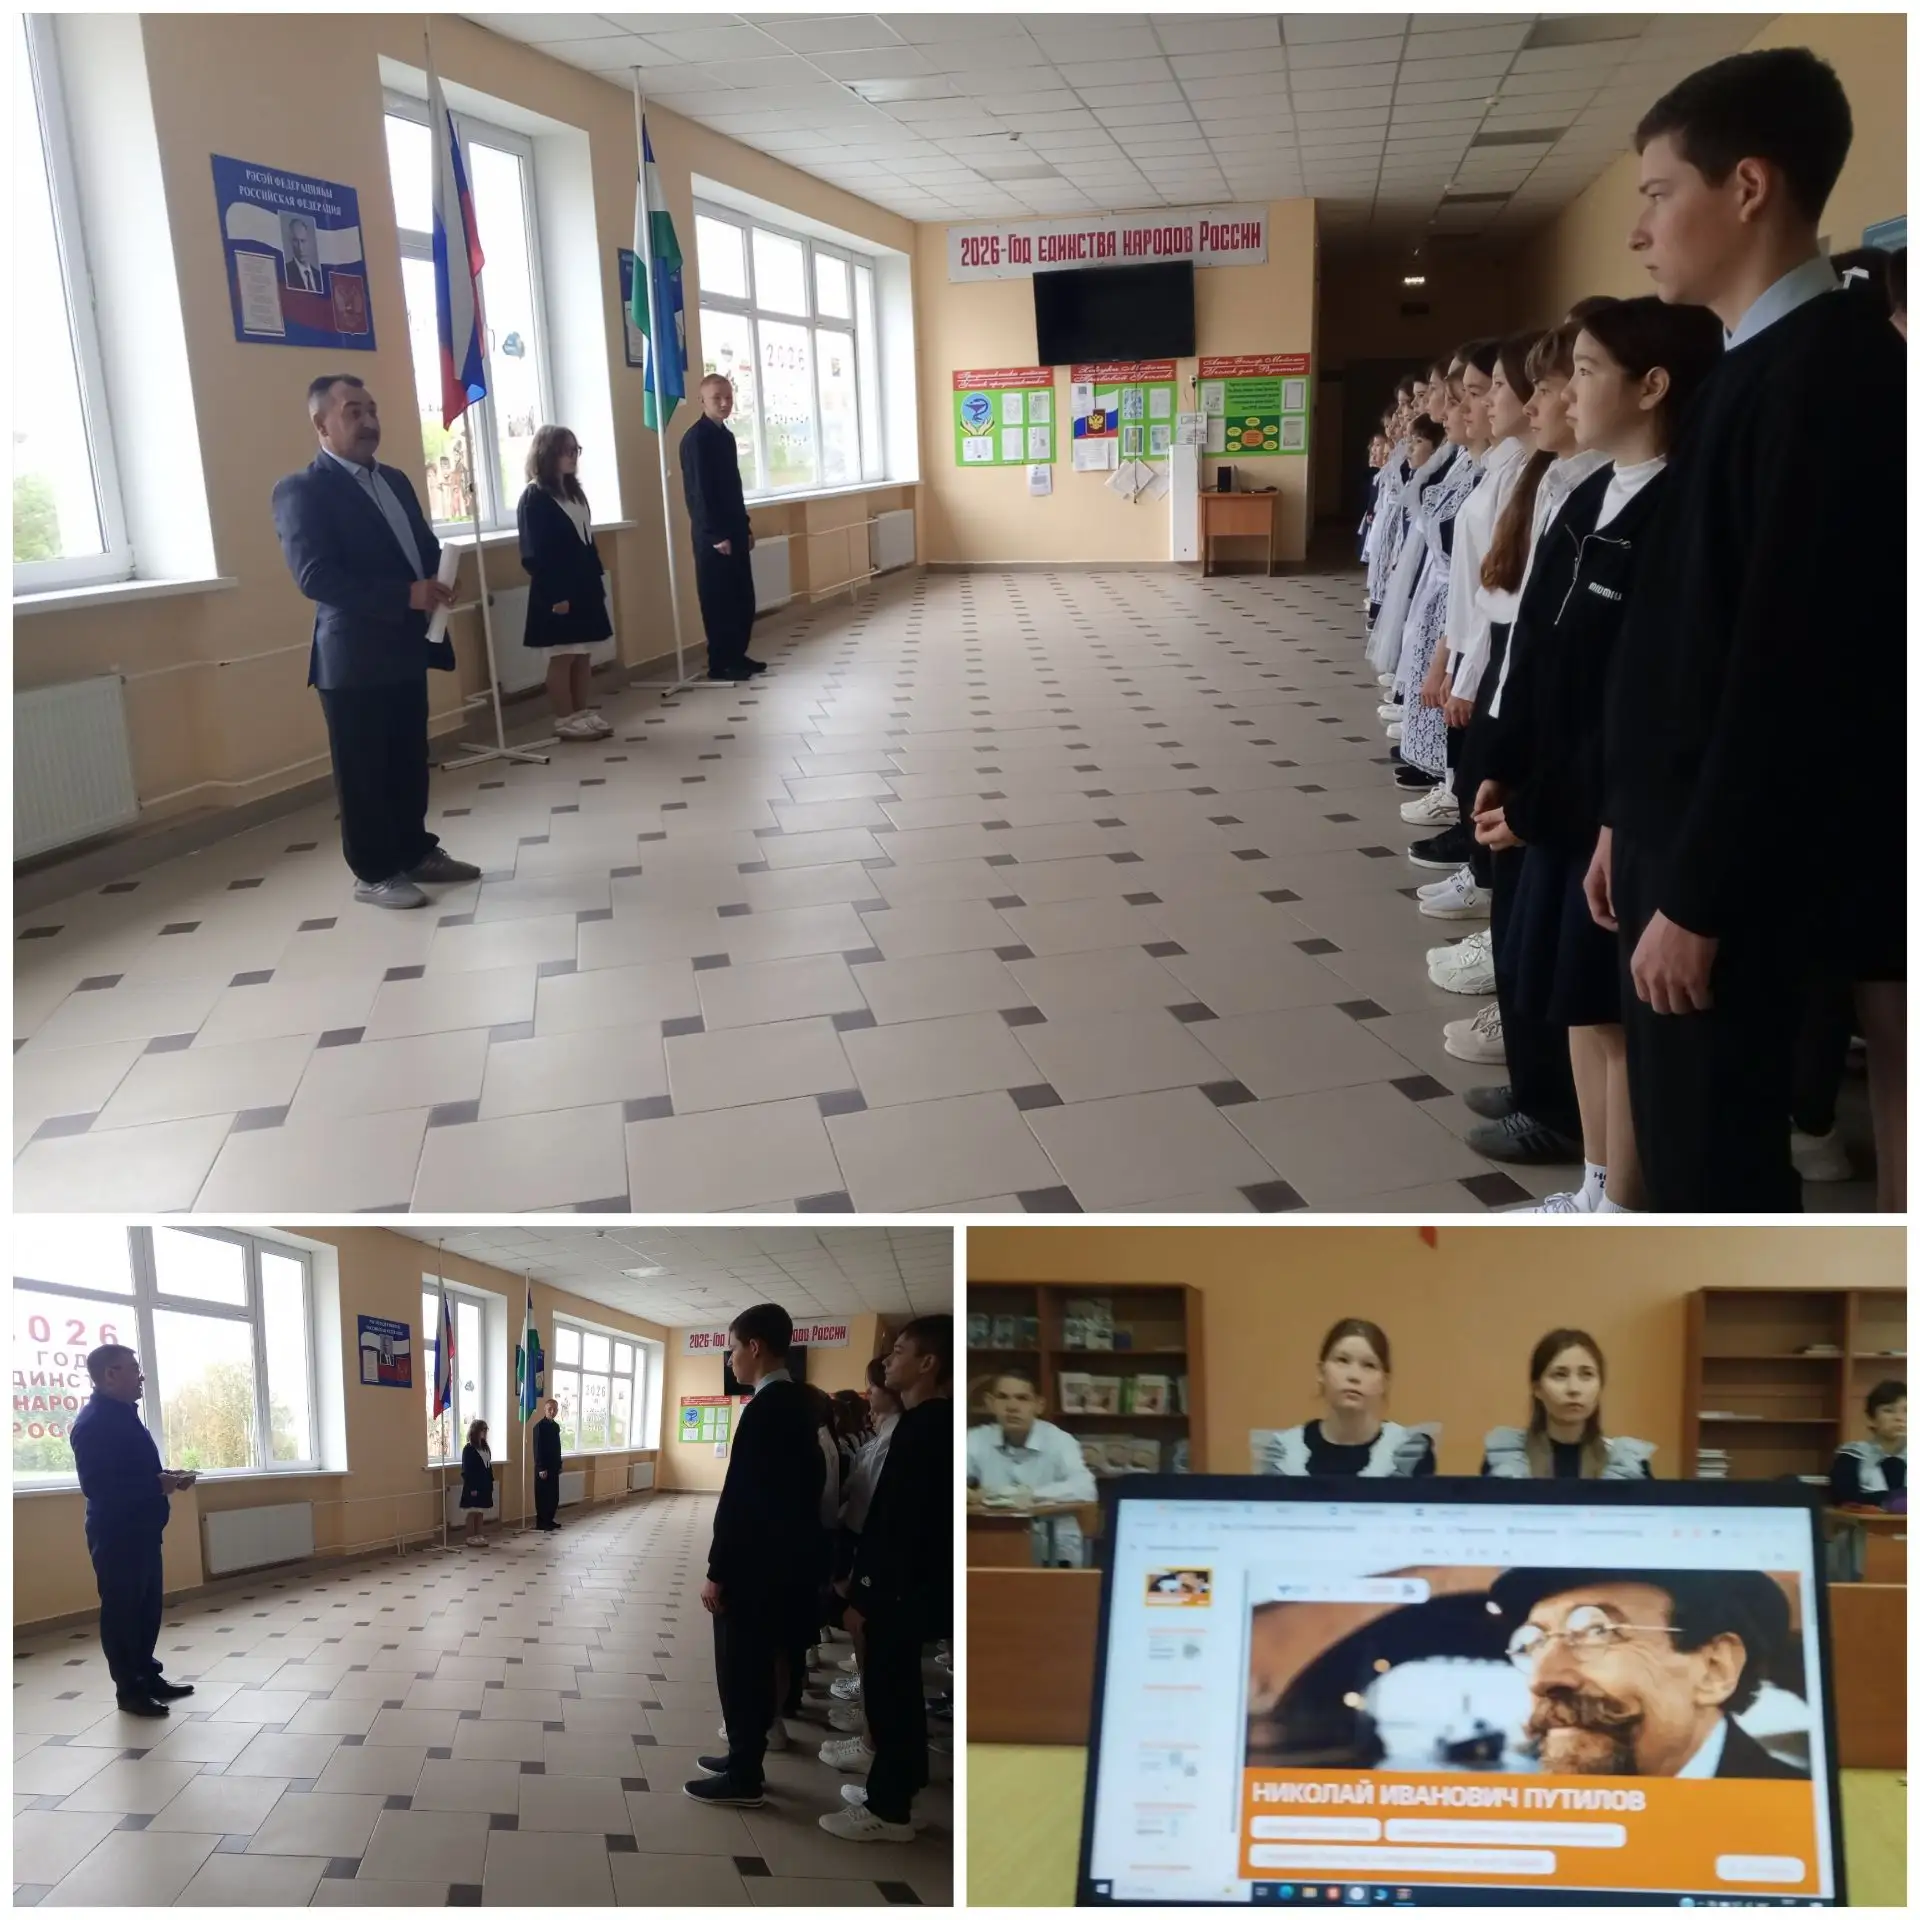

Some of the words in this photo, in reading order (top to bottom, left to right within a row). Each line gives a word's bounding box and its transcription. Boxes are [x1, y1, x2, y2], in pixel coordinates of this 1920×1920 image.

[239, 185, 295, 207] РОССИЙСКАЯ
[296, 198, 342, 217] ФЕДЕРАЦИЯ
[13, 1315, 118, 1345] 026
[1252, 1780, 1374, 1805] НИКОЛАЙ
[1380, 1785, 1519, 1807] ИВАНОВИЧ
[1524, 1788, 1646, 1811] ПУТИЛОВ
